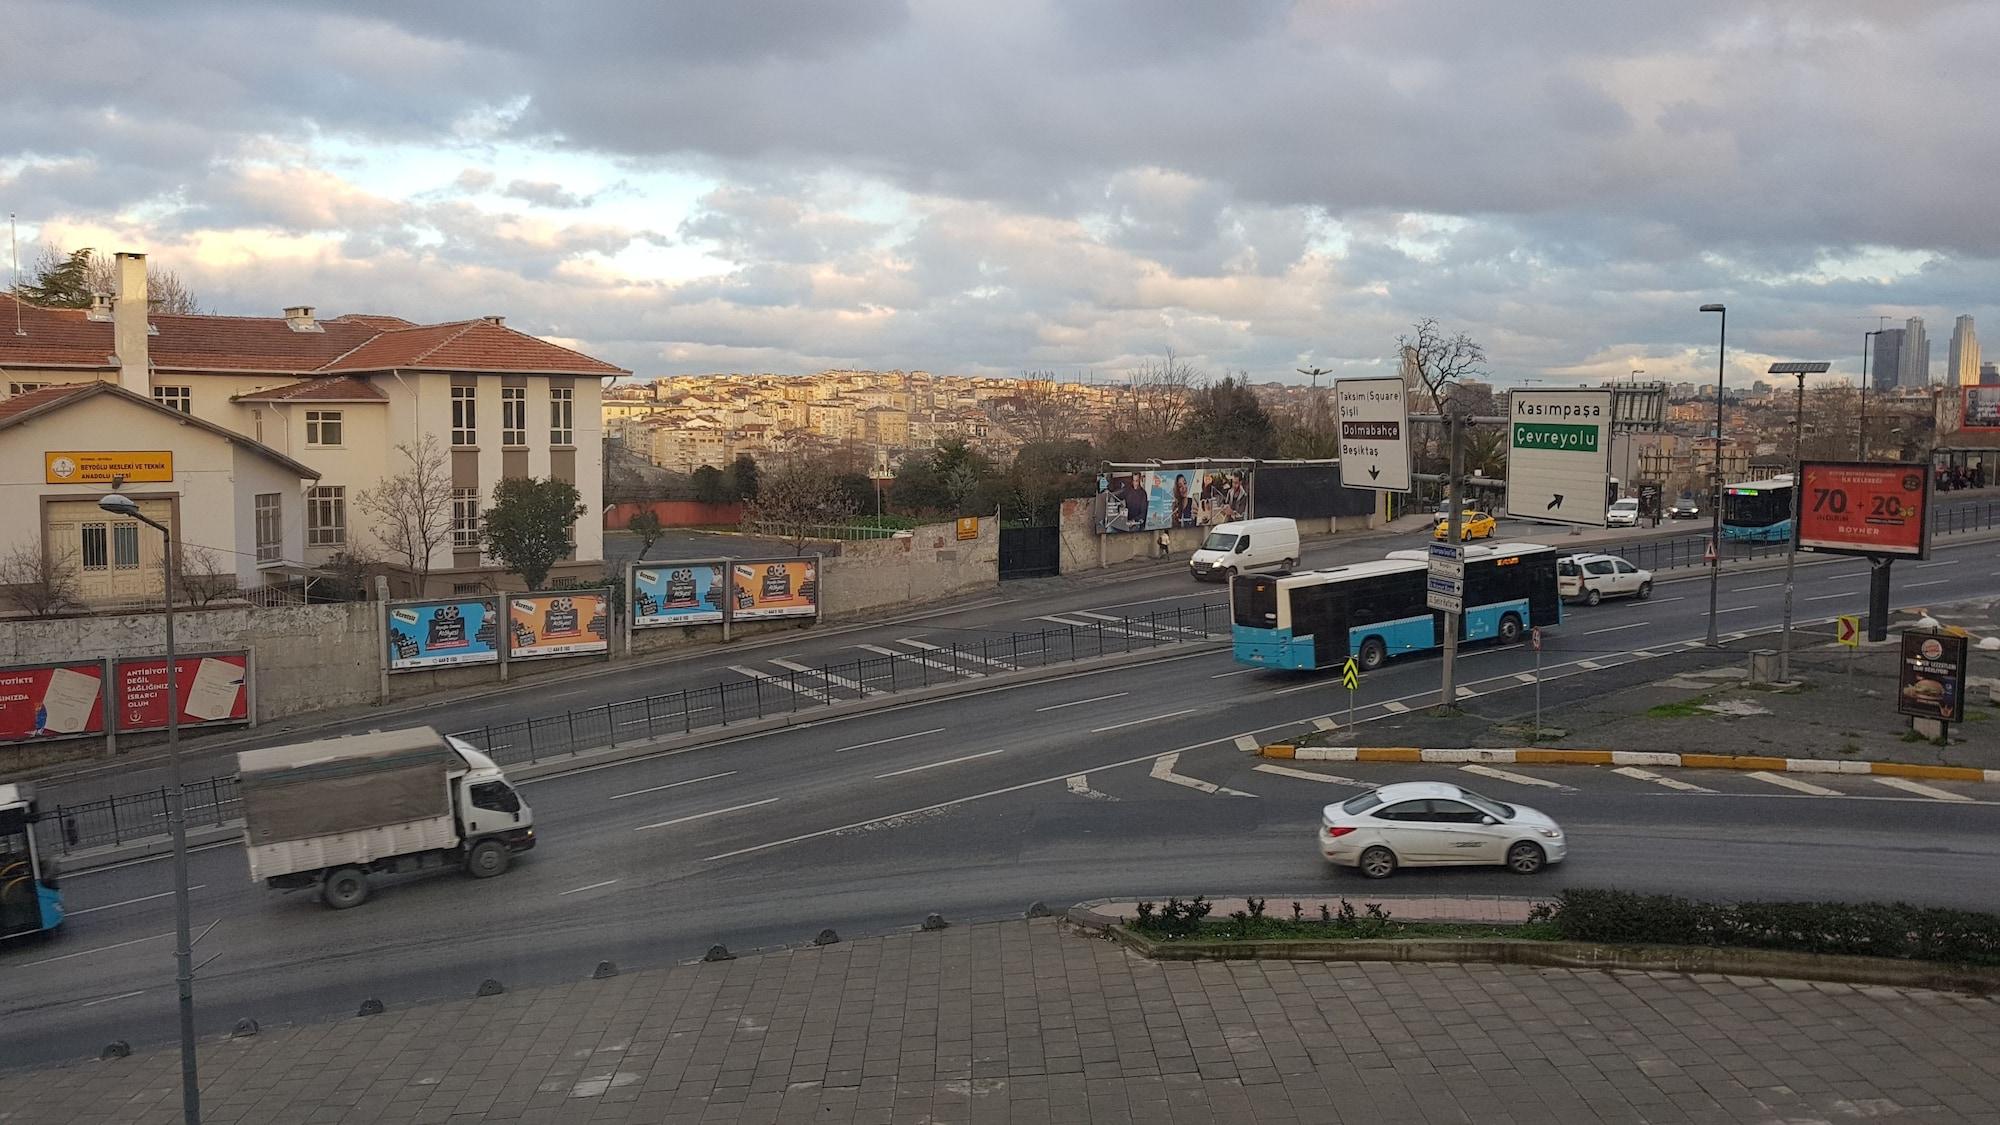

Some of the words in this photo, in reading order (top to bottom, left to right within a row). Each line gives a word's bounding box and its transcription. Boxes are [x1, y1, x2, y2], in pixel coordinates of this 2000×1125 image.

[1340, 405, 1359, 418] Şişli
[1518, 400, 1600, 420] Kasımpaşa
[1343, 424, 1398, 437] Dolmabahçe
[1517, 427, 1595, 448] Çevreyolu
[1343, 444, 1379, 457] Beşiktaş
[81, 463, 108, 471] BEYOĞLU
[1812, 488, 1848, 514] 70
[1871, 495, 1901, 516] 20
[1838, 526, 1880, 535] BOYNER
[127, 666, 183, 676] ANTİBİYOTİTE
[127, 676, 149, 684] DEĞİL
[127, 682, 179, 692] SAĞLIĞINIZA
